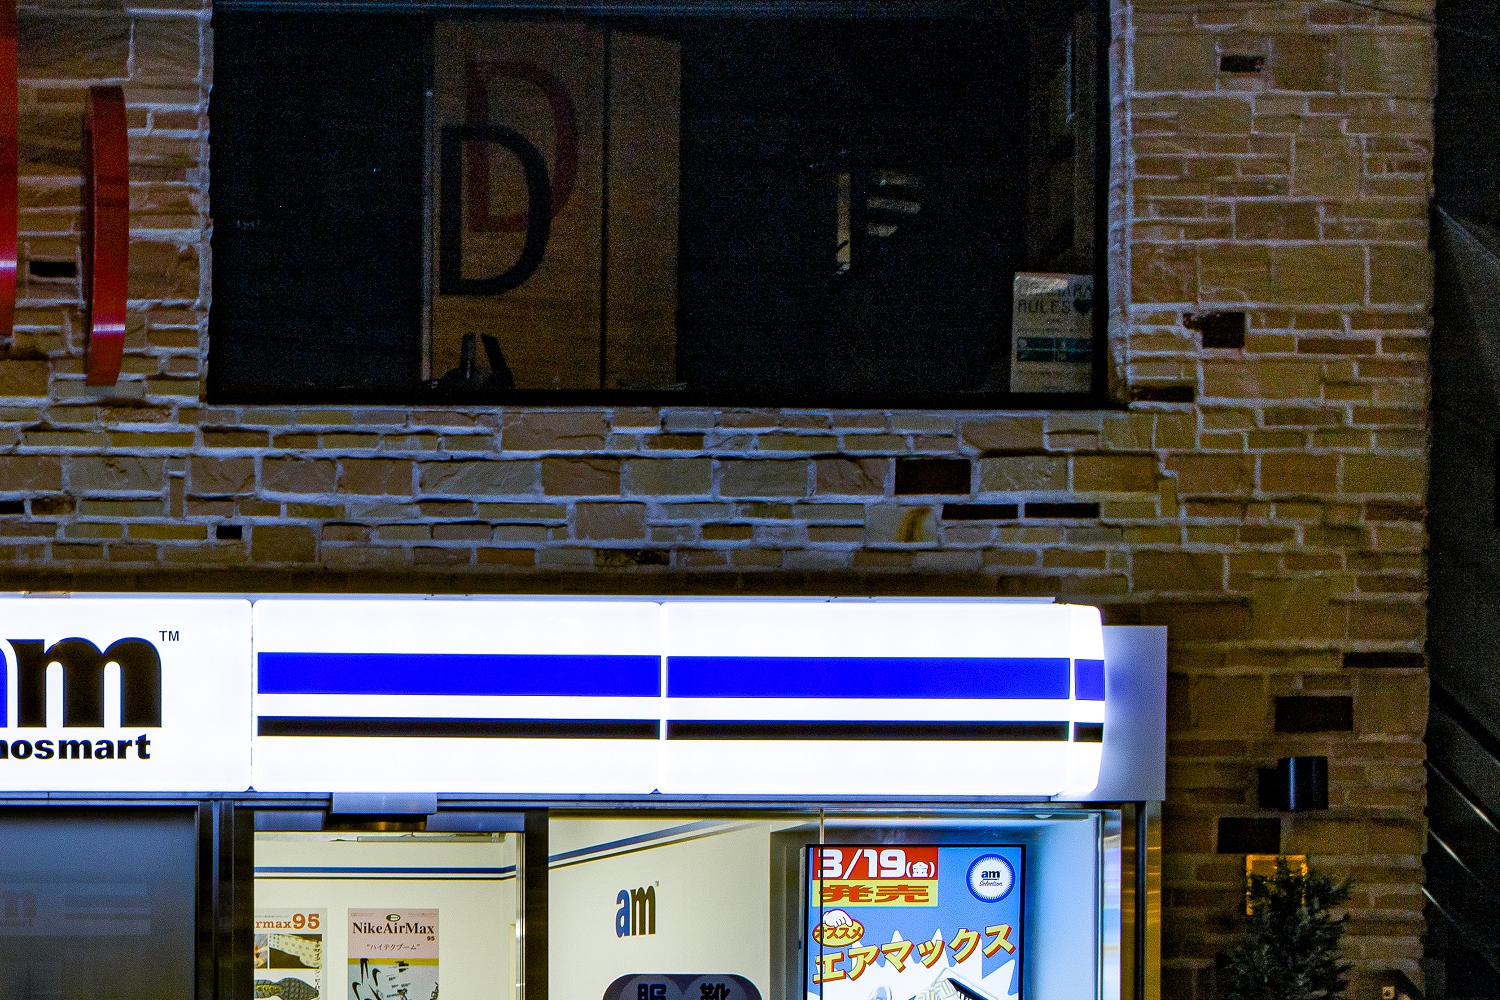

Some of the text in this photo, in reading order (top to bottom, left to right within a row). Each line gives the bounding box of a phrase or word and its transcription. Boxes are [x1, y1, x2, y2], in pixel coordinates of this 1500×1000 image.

[438, 124, 553, 296] D
[981, 870, 1001, 878] am
[818, 884, 930, 904] 発売
[255, 912, 320, 930] rmax95
[615, 885, 656, 938] am
[352, 922, 435, 934] NikeAirMax
[815, 926, 862, 940] オススメ
[812, 923, 1017, 984] エアマックス
